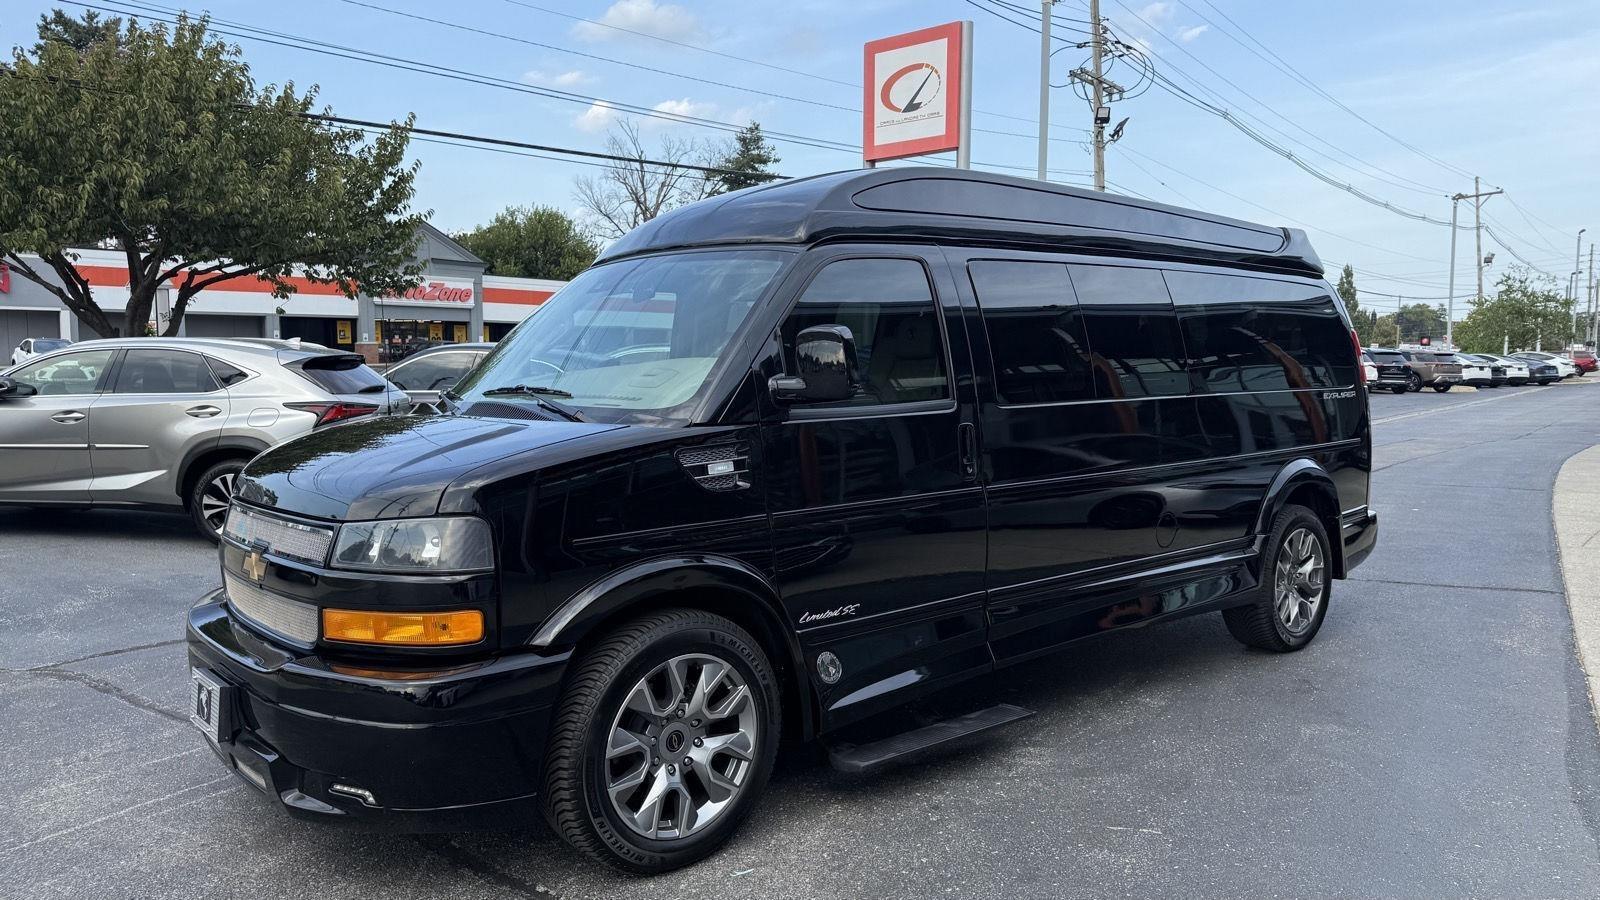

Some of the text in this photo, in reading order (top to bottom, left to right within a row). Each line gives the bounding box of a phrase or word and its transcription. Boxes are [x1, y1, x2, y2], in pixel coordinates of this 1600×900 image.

[799, 603, 861, 624] Limited SE
[728, 639, 768, 682] MICHELIN
[596, 821, 645, 863] MICHELIN
